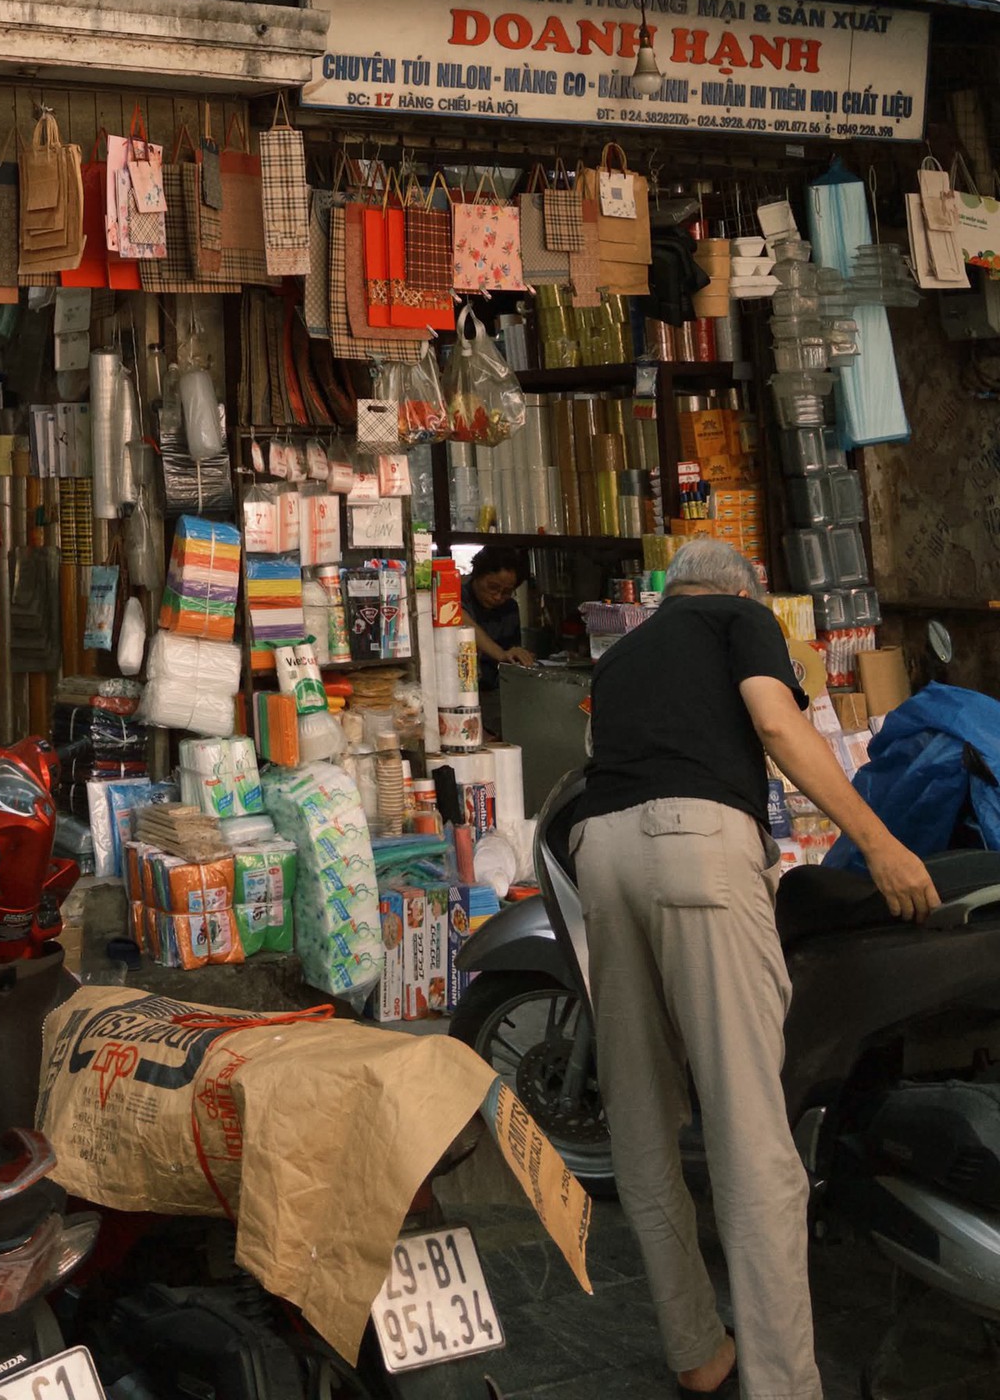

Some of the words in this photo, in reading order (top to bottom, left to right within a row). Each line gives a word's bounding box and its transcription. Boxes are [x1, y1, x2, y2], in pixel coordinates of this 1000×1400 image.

[447, 7, 658, 59] DOANH
[669, 26, 823, 75] HẠNH
[753, 4, 772, 23] &
[778, 0, 825, 28] SẢN
[832, 6, 893, 34] XUẤT
[322, 51, 397, 83] CHUYÊN
[401, 54, 431, 86] TÚI
[436, 62, 492, 91] NILON
[504, 62, 557, 95] MÀNG
[563, 71, 586, 97] CO
[701, 78, 746, 114] NHẬN
[750, 84, 767, 109] IN
[769, 83, 807, 111] TRÊN
[811, 90, 838, 120] MỌI
[842, 85, 880, 117] CHẤT
[882, 90, 913, 124] LIỆU
[347, 92, 371, 106] ĐC:
[374, 92, 394, 107] 17
[398, 93, 435, 111] HÀNG
[497, 97, 519, 116] NỘI
[383, 1290, 494, 1360] 954.34
